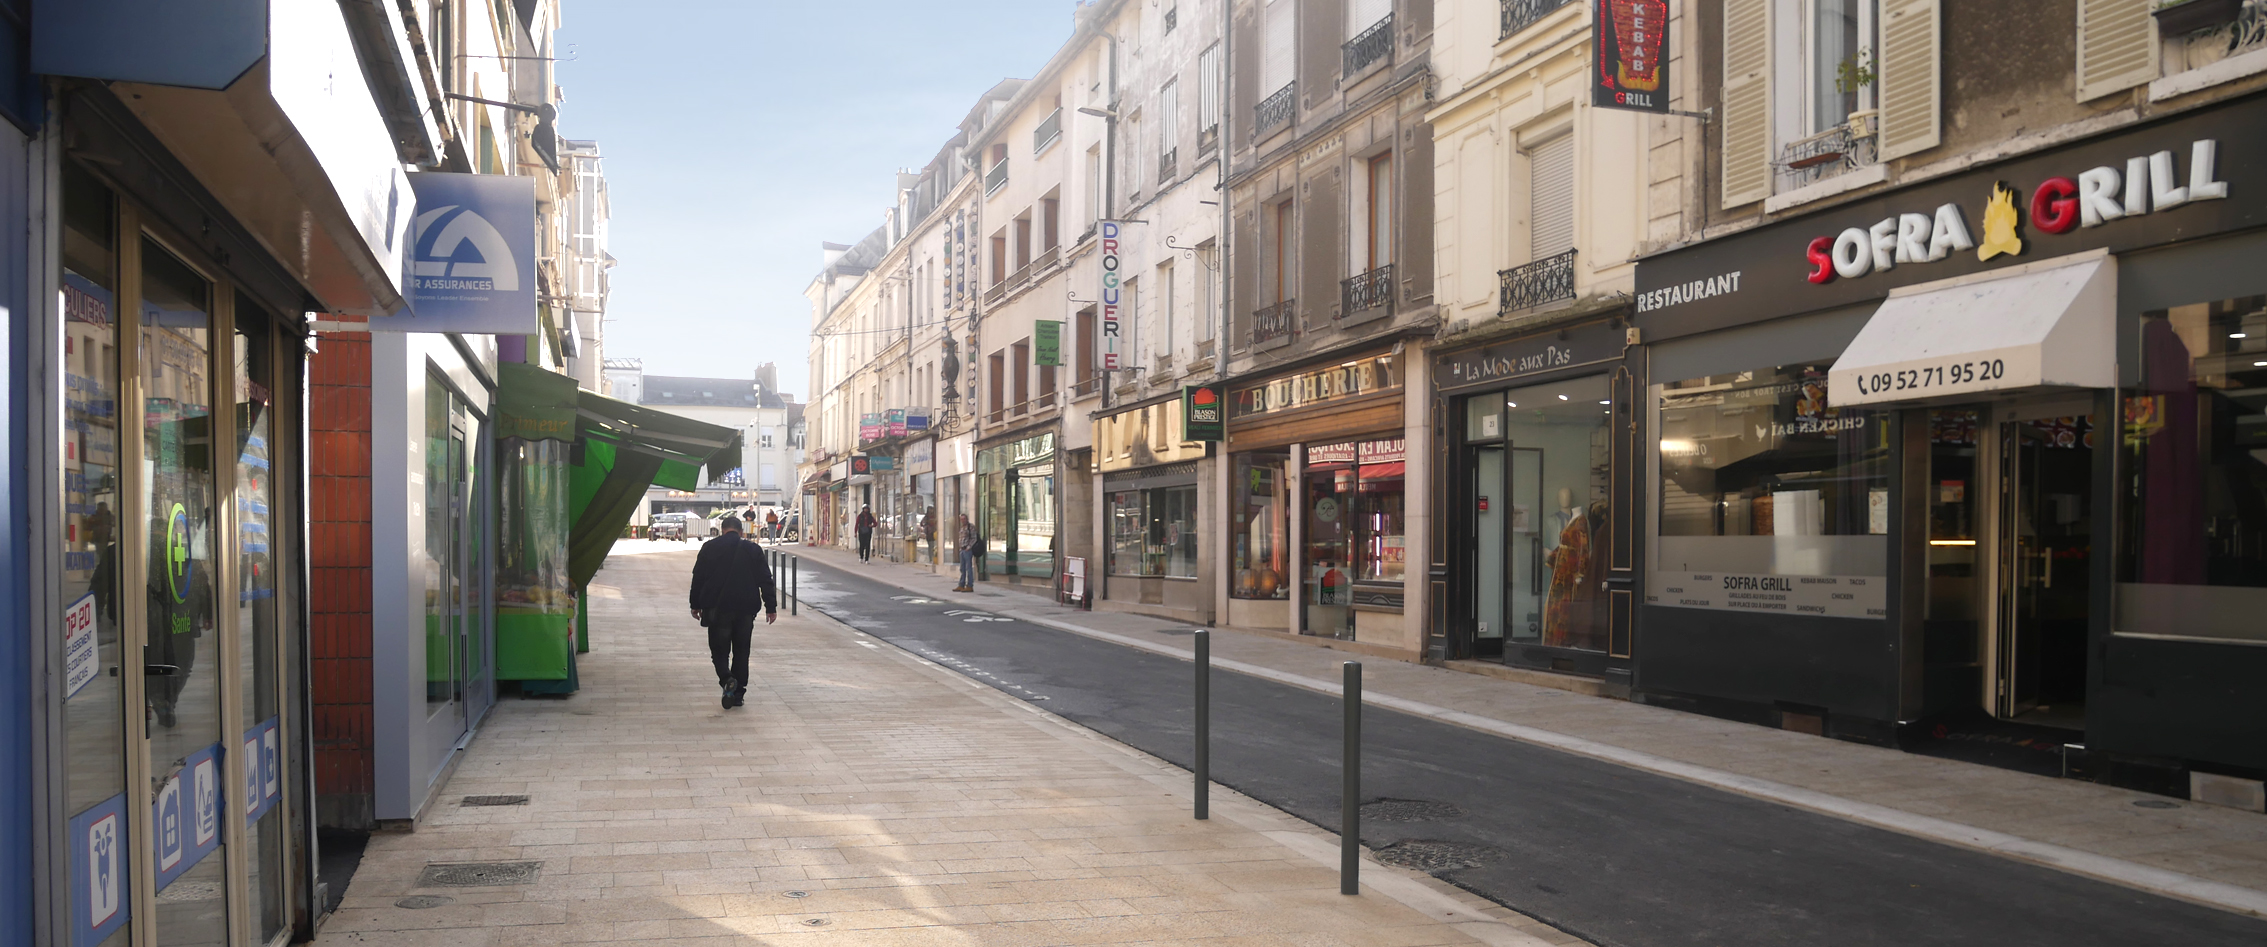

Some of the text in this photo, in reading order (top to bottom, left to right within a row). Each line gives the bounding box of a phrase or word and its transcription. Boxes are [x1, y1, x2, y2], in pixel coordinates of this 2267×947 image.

[1632, 3, 1645, 71] KEBAB
[1615, 92, 1653, 107] GRILL
[1807, 139, 2228, 285] SOFRA GRILL
[424, 279, 492, 291] ASSURANCES
[1103, 222, 1119, 369] DROGUERIE
[1637, 270, 1741, 313] RESTAURANT
[1466, 345, 1571, 381] La Mode aux Pas
[1871, 359, 2004, 393] 09 52 71 95 20
[1252, 362, 1372, 412] BOUCHERIE
[500, 413, 568, 432] Primeur
[1723, 576, 1792, 591] SOFRA GRILL
[79, 602, 91, 631] 20
[1763, 602, 1787, 610] EMPORTER
[172, 609, 191, 635] Santé
[71, 646, 93, 671] COURTIERS
